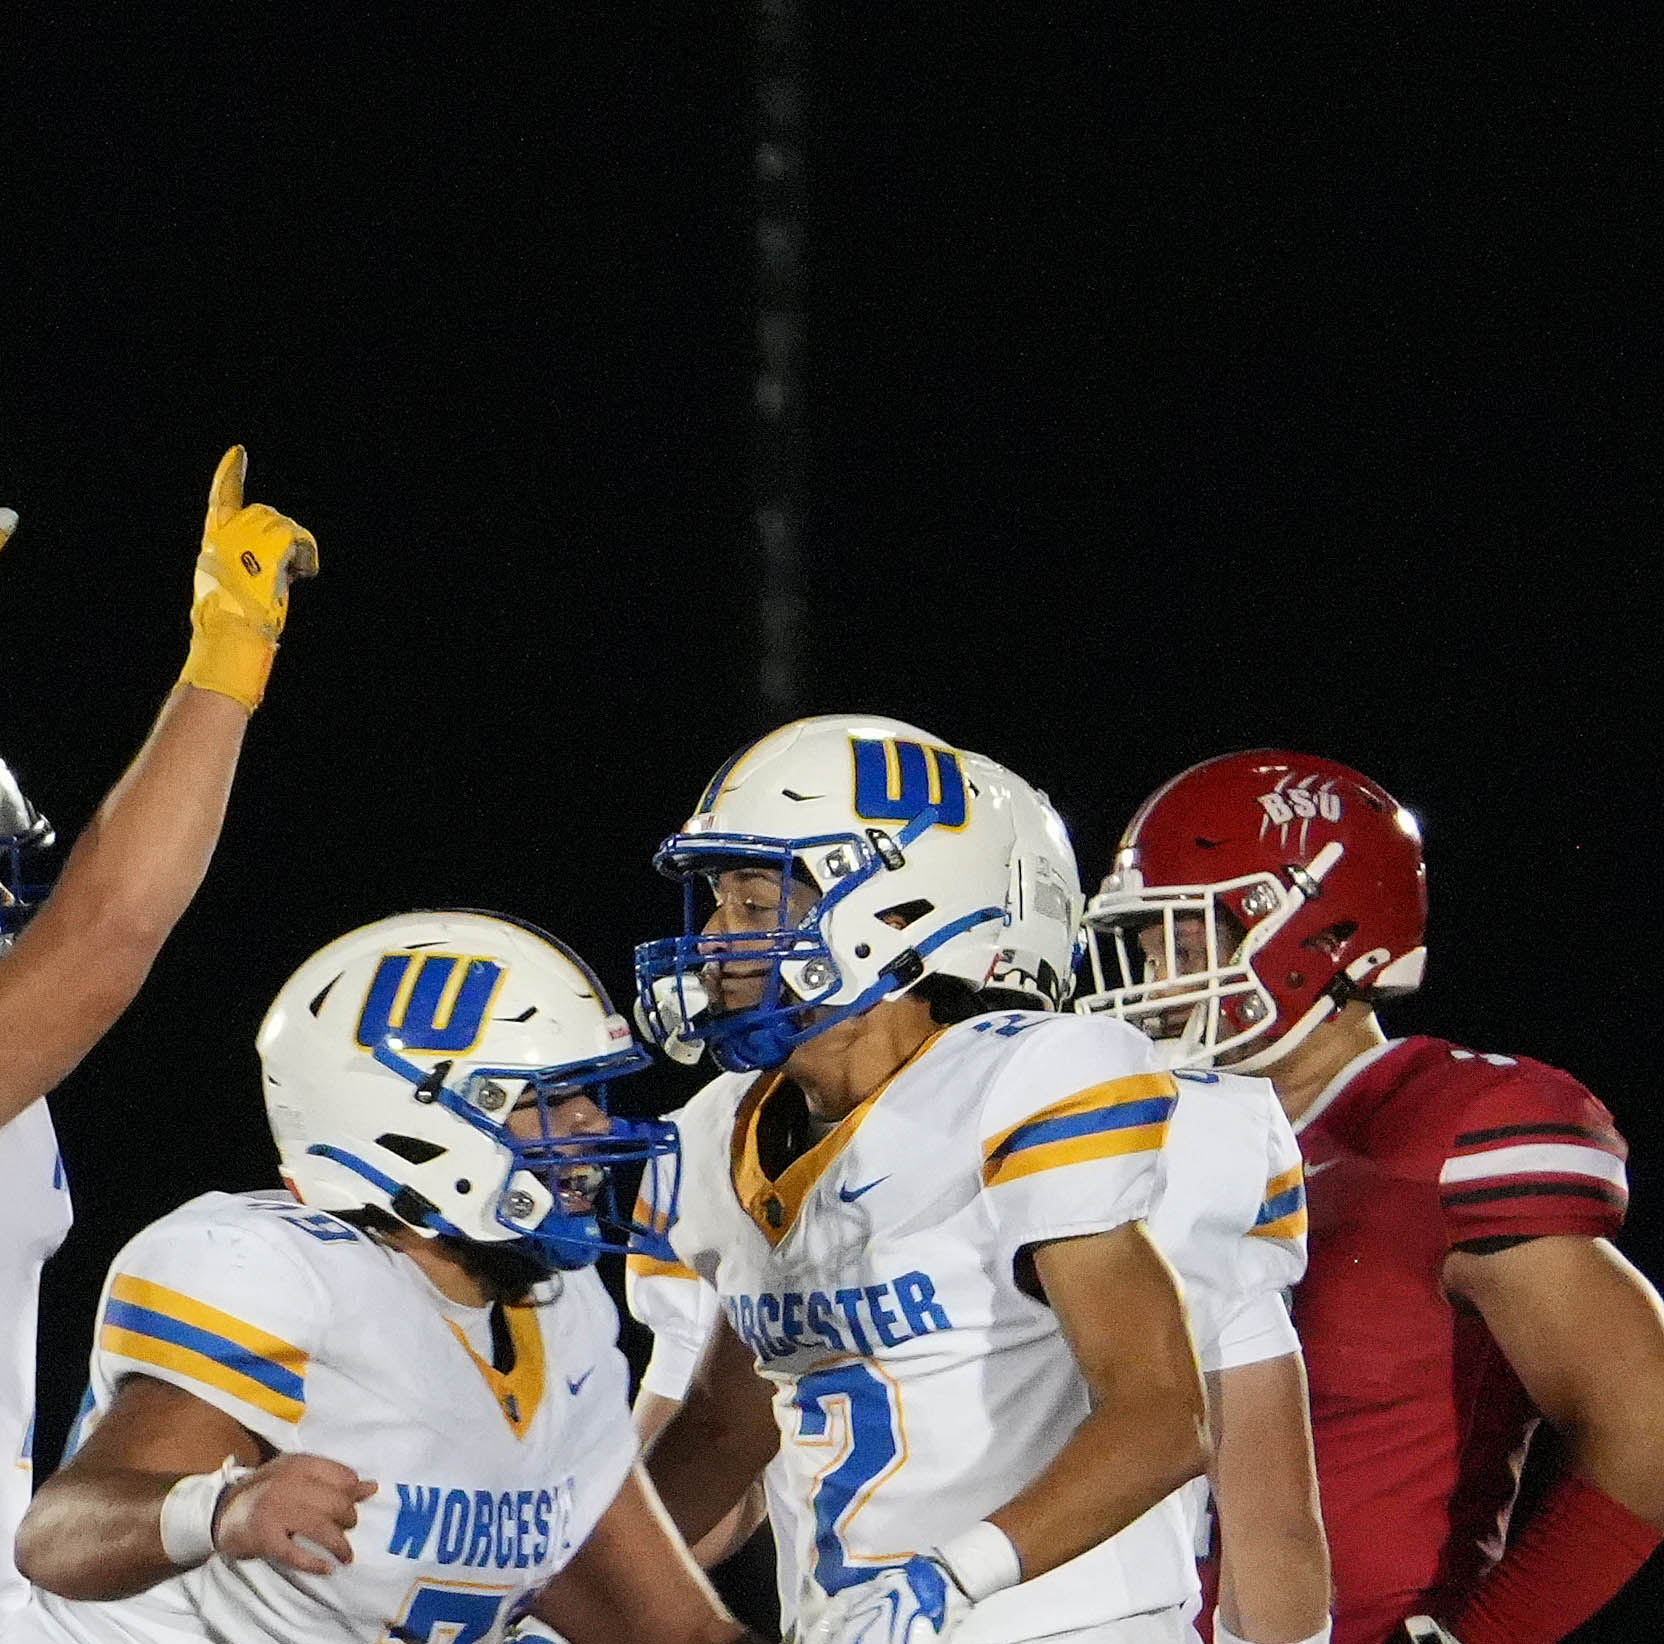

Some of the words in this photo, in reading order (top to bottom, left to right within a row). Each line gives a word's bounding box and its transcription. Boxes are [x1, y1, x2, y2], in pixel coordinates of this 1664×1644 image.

[1256, 788, 1341, 824] BSU
[355, 951, 507, 1057] W
[793, 1353, 910, 1599] 2
